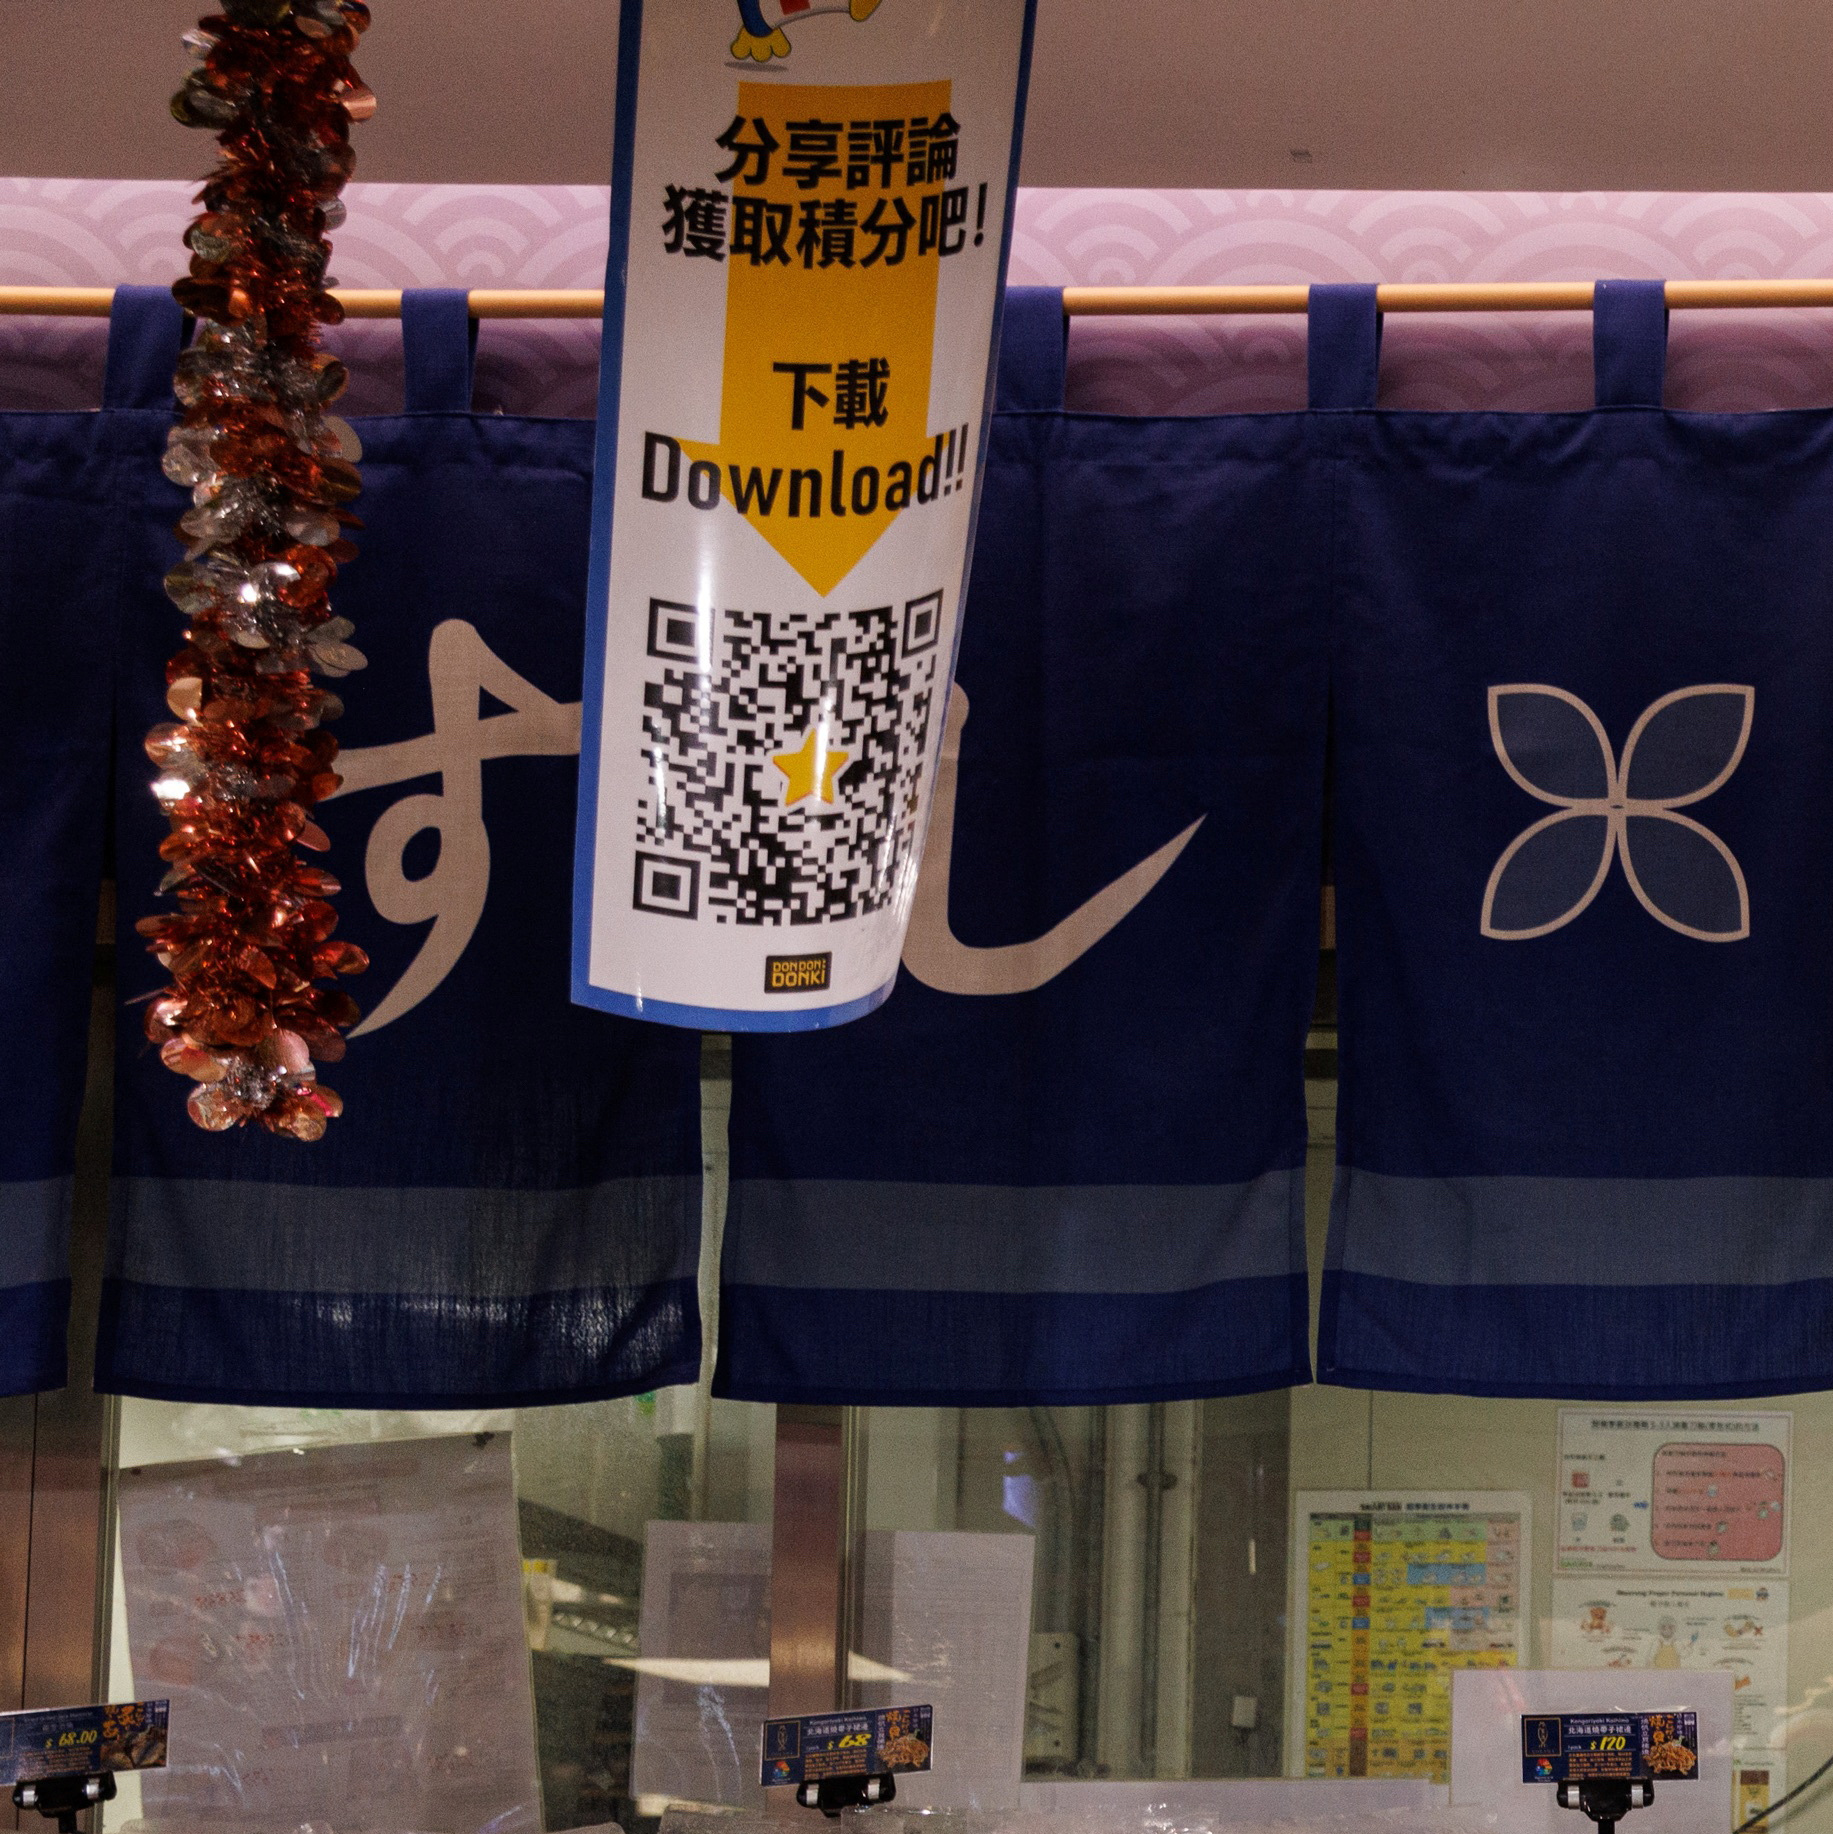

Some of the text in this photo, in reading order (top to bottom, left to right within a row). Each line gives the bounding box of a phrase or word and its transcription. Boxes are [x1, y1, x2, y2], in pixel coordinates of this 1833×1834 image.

[715, 114, 960, 191] 分享評論
[662, 182, 985, 268] 獲取積分吧!
[771, 357, 890, 433] 下載
[643, 423, 967, 518] Download!!
[59, 1728, 97, 1747] 68.00
[839, 1733, 872, 1748] 68
[1600, 1737, 1626, 1750] 120
